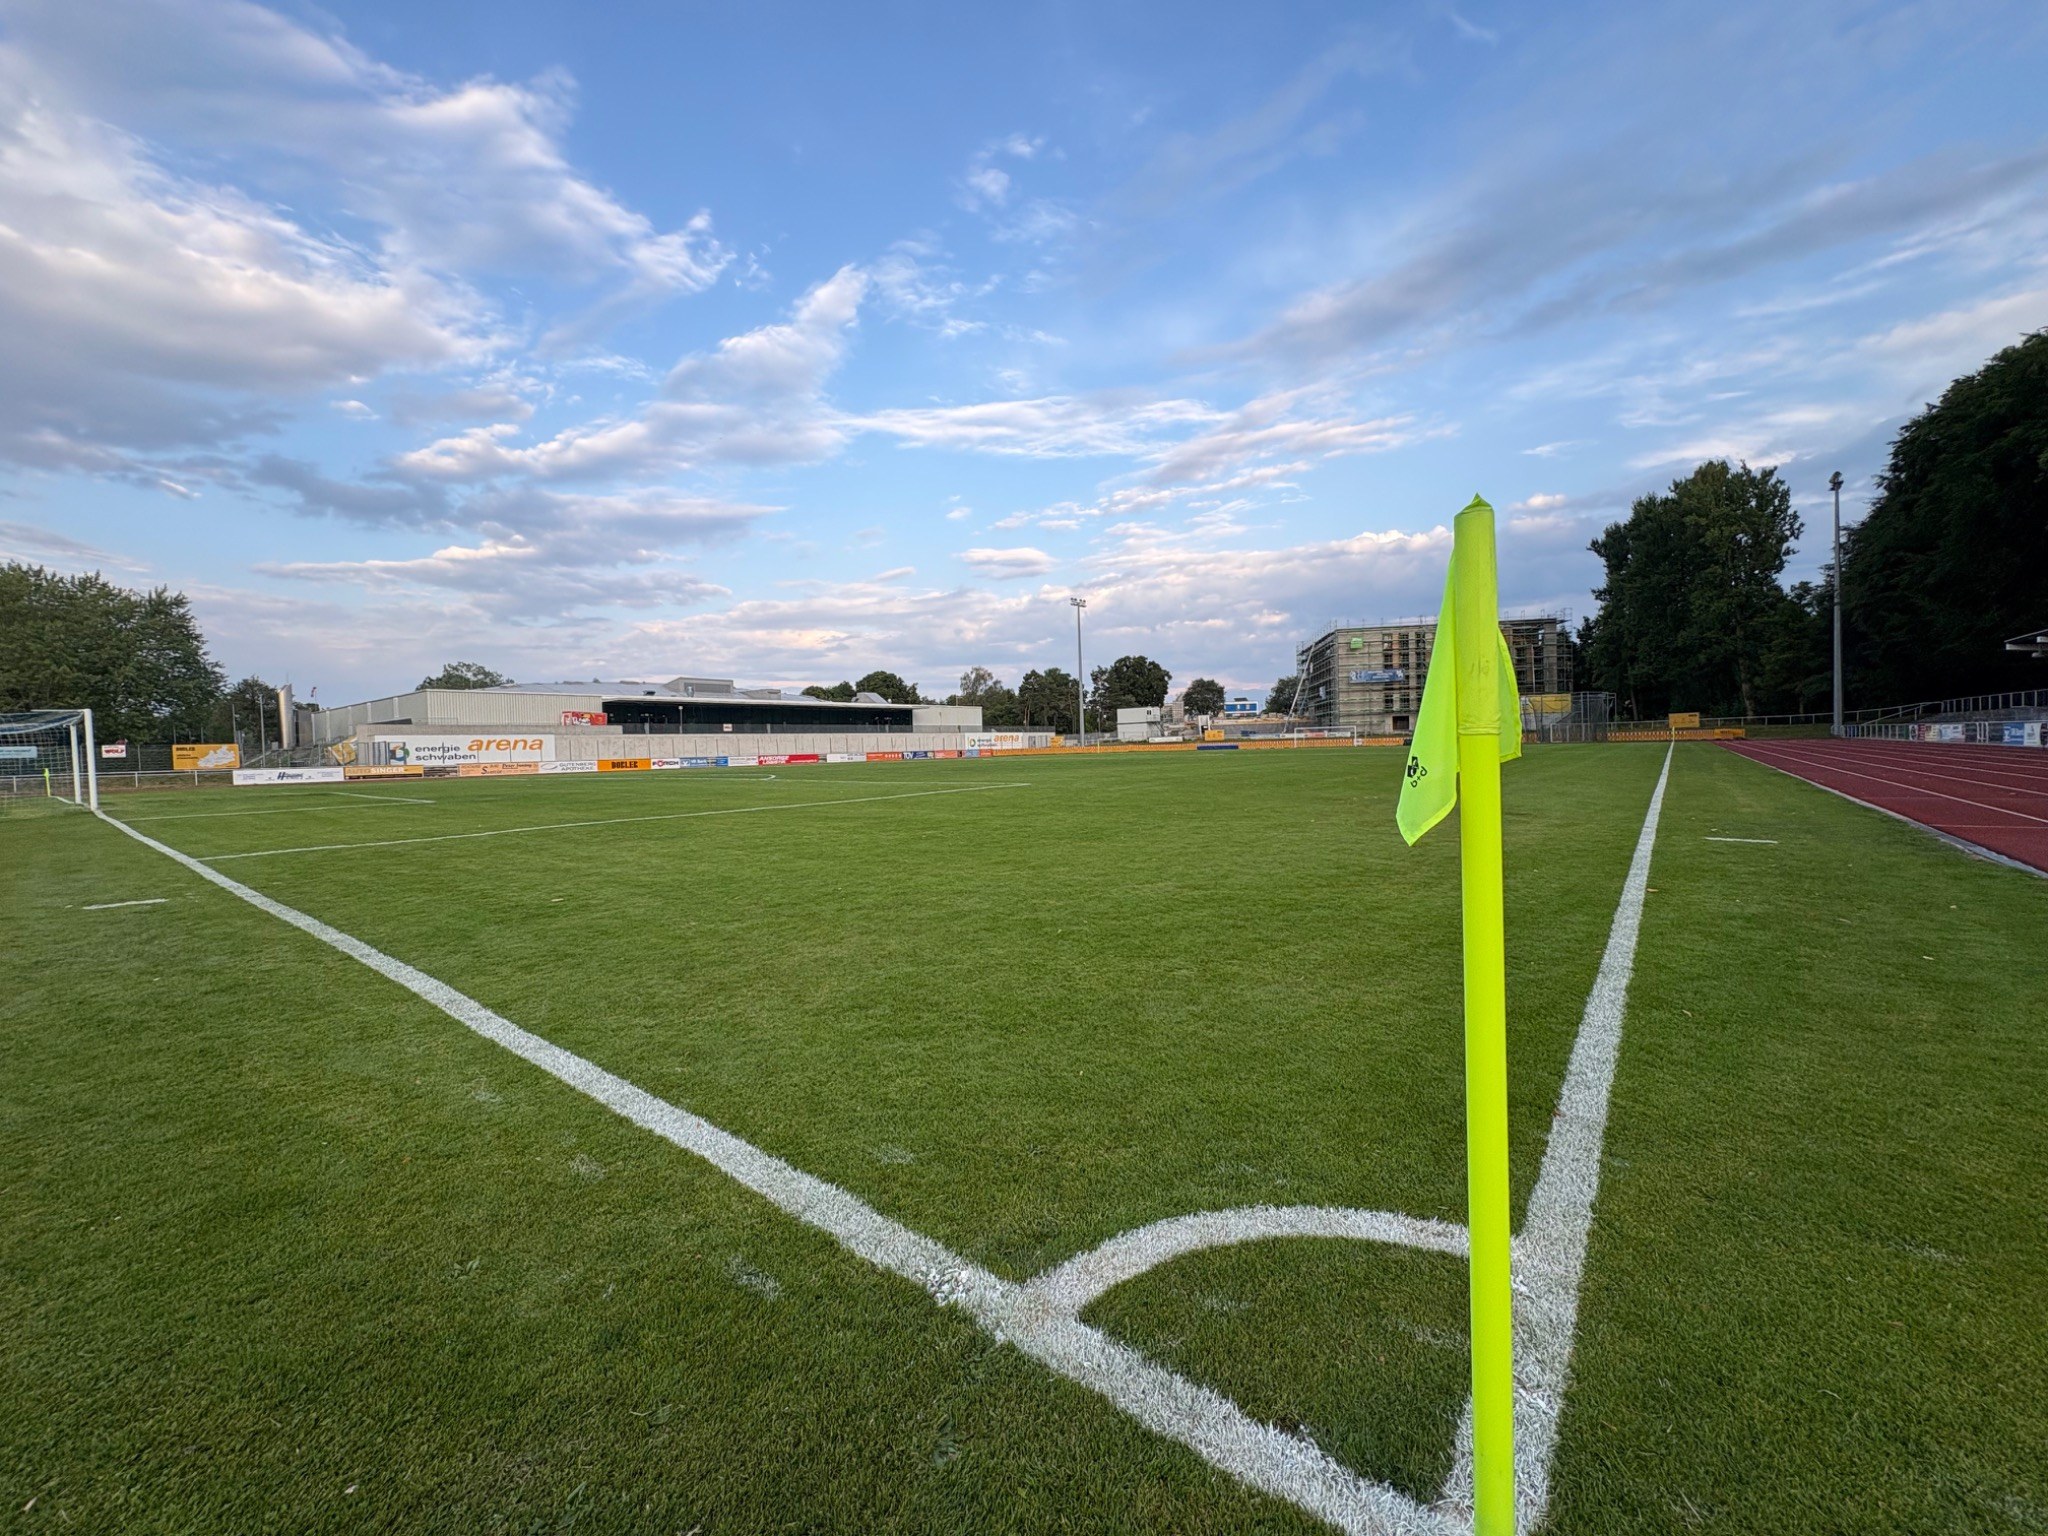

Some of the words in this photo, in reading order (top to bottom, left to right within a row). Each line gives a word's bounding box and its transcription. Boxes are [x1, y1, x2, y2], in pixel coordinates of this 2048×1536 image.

[993, 734, 1020, 742] arena
[415, 744, 461, 754] energie
[467, 738, 544, 751] arena
[415, 752, 476, 761] schwaben
[1410, 766, 1428, 788] b+d
